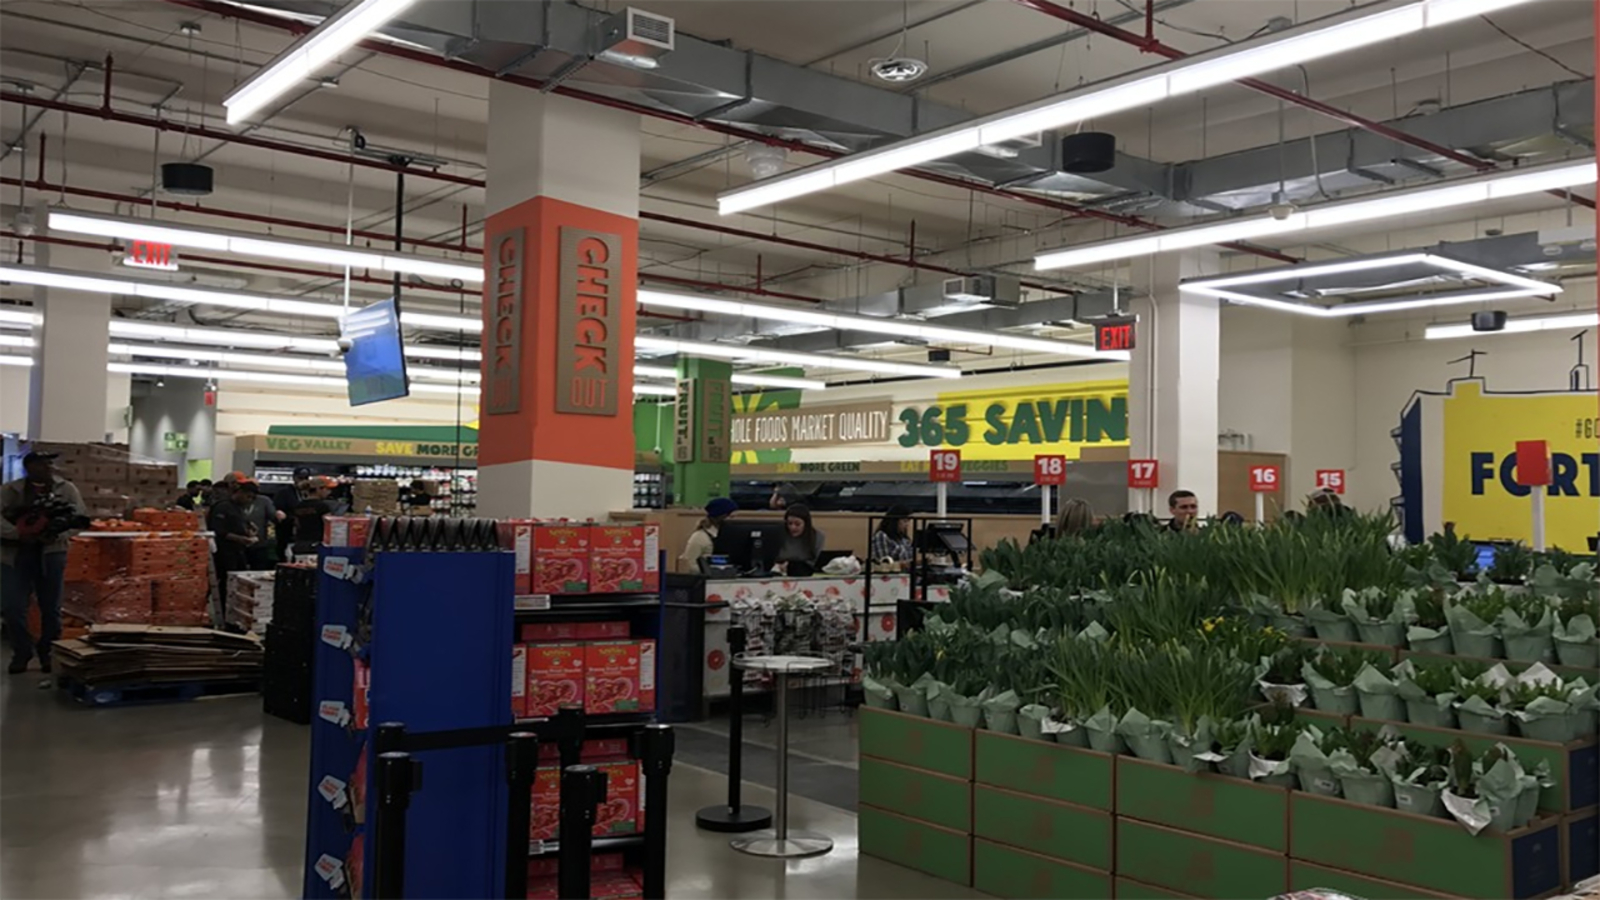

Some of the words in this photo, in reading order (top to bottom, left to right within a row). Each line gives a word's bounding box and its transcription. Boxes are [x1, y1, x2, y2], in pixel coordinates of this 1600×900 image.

[133, 239, 171, 266] EXIT
[494, 236, 516, 373] CHECK
[574, 236, 609, 375] CHECK
[1101, 325, 1131, 350] EXIT
[571, 377, 608, 408] OUT
[677, 381, 690, 439] FRUIT
[755, 416, 788, 443] FOODS
[791, 414, 835, 442] MARKET
[838, 411, 888, 442] QUALITY
[898, 403, 970, 448] 365
[983, 396, 1127, 446] SAVIN
[266, 437, 301, 450] VEG
[303, 439, 351, 450] VALLEY
[375, 441, 413, 456] SAVE
[416, 444, 459, 456] MORE
[800, 462, 825, 472] MORE
[828, 462, 860, 472] GREEN
[933, 452, 958, 471] 19
[1037, 457, 1062, 475] 18
[1131, 462, 1155, 479] 17
[1252, 468, 1276, 484] 16
[1319, 472, 1342, 487] 15
